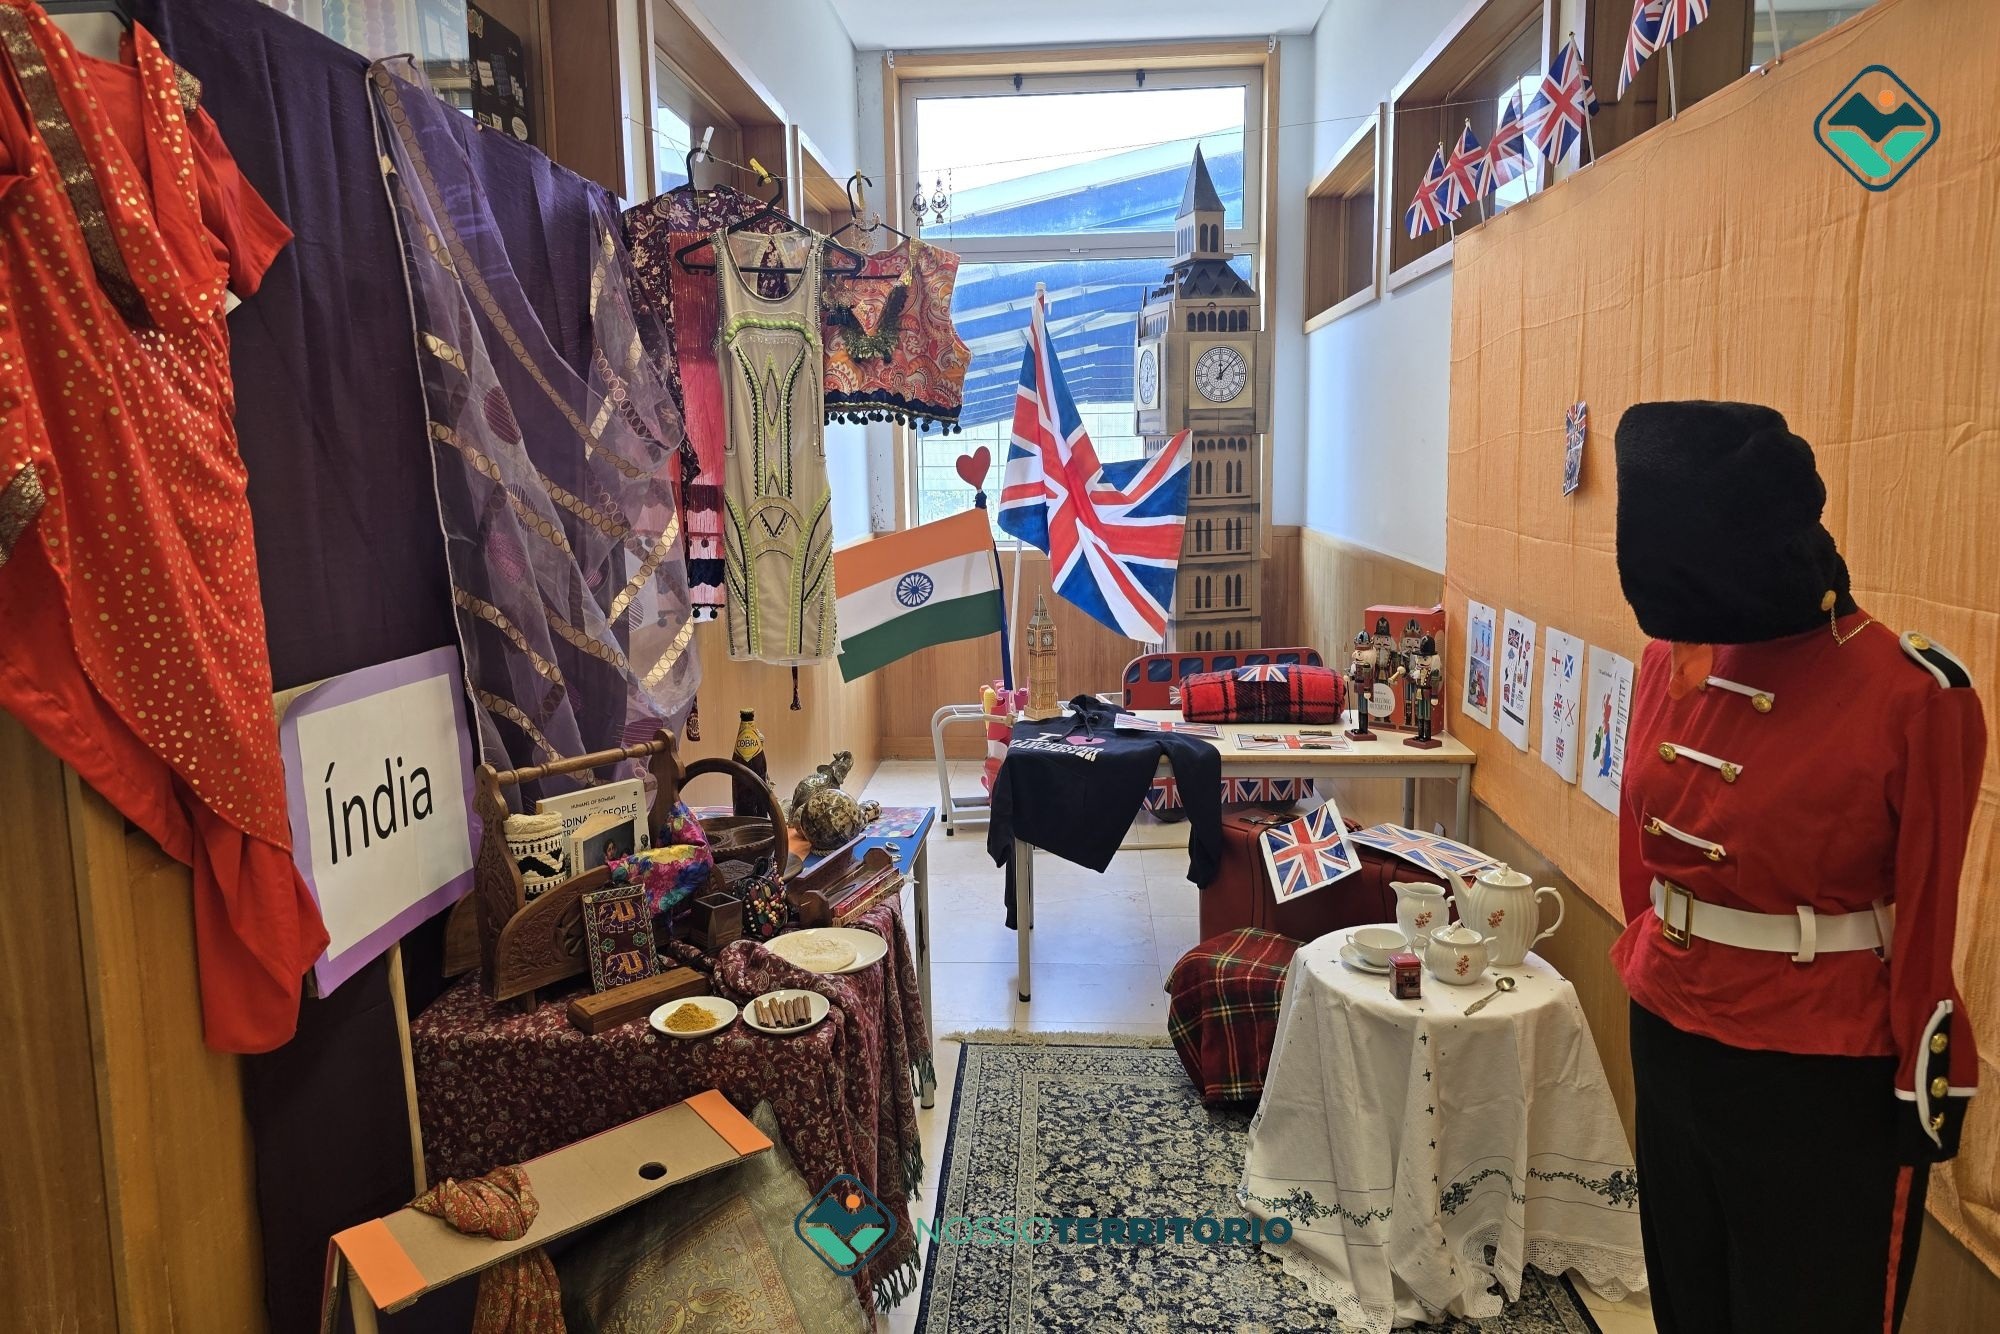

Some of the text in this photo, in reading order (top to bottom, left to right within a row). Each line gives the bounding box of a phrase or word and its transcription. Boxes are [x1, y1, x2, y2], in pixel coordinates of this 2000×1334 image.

[737, 739, 759, 748] COBRA
[1026, 732, 1062, 742] I
[1009, 739, 1105, 762] MANCHESTER
[571, 801, 590, 809] HUMANS
[598, 795, 616, 804] BOMBAY
[324, 756, 433, 865] Índia
[603, 803, 637, 815] PEOPLE
